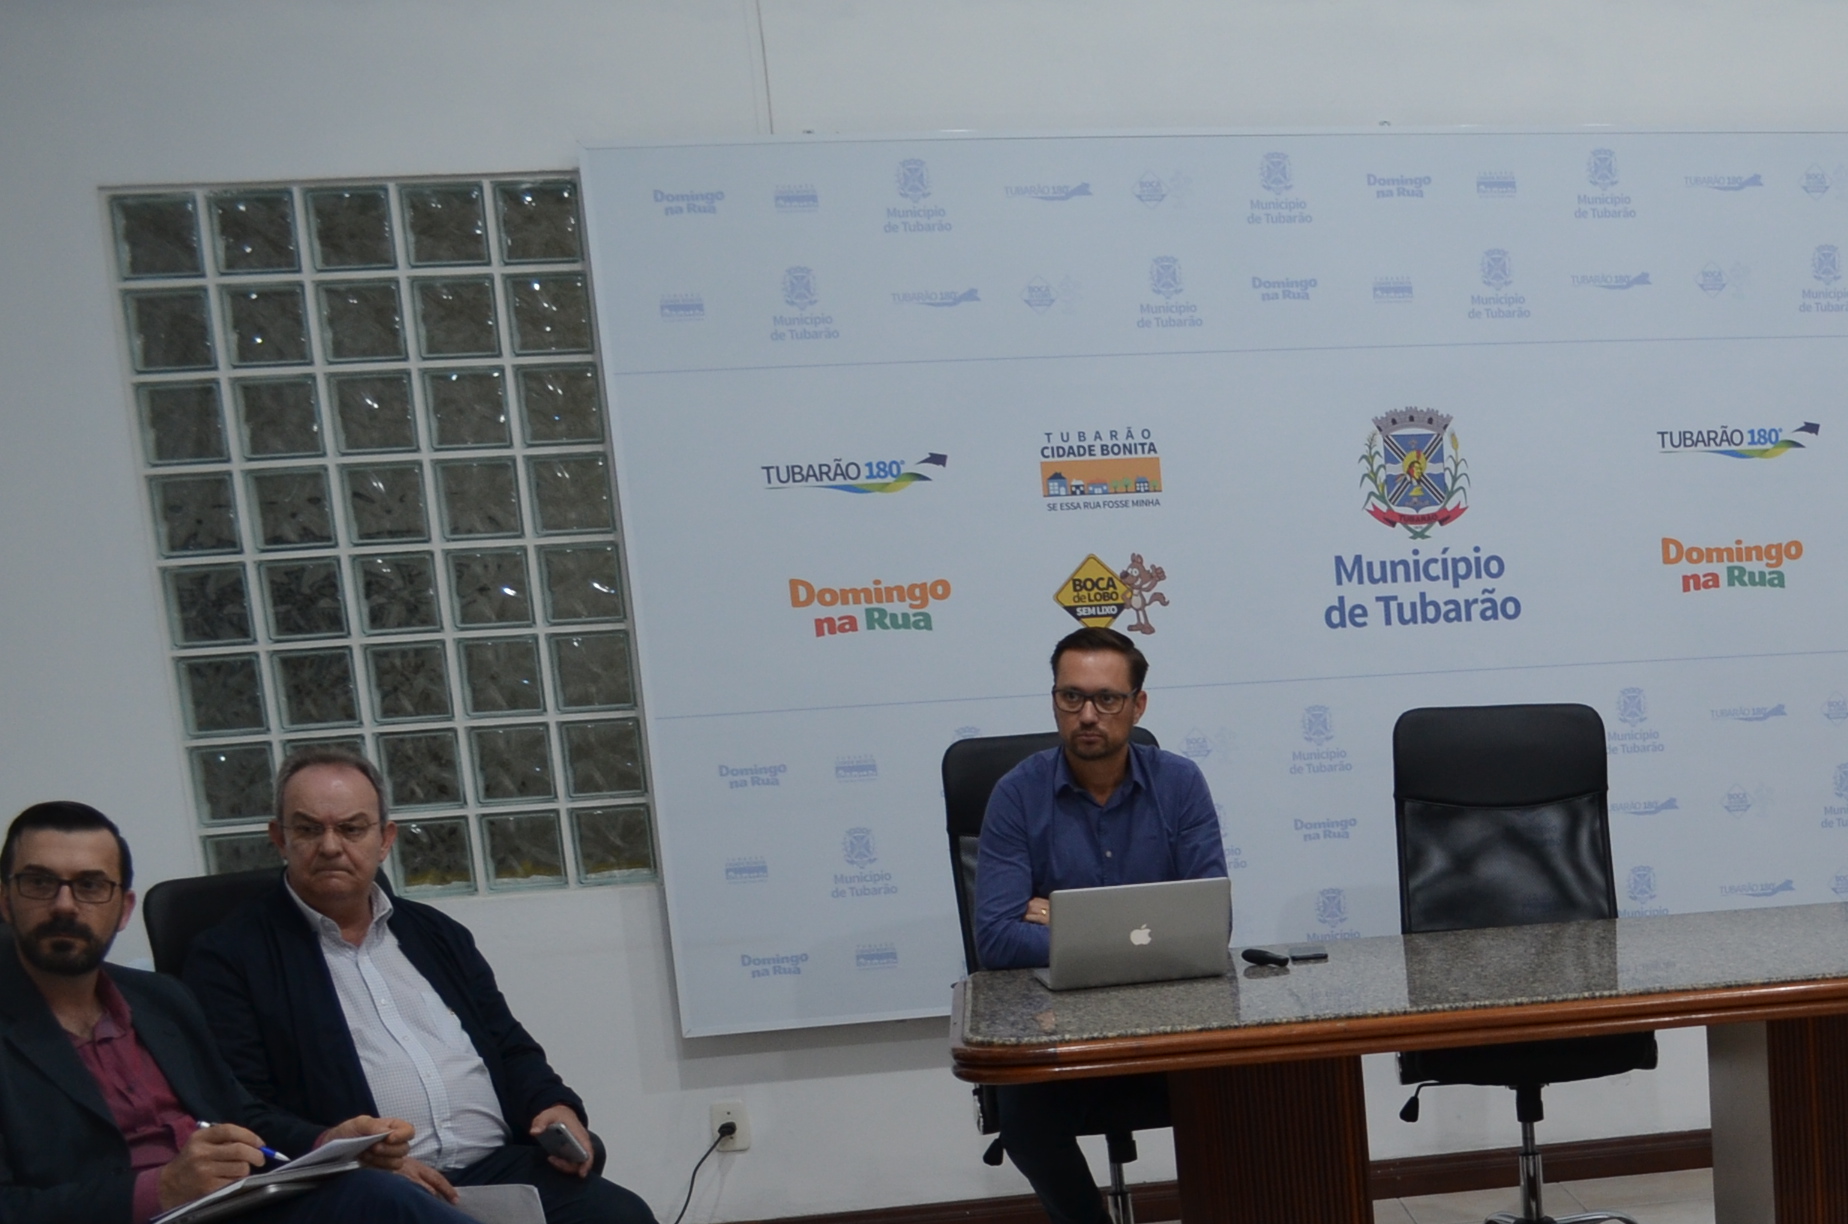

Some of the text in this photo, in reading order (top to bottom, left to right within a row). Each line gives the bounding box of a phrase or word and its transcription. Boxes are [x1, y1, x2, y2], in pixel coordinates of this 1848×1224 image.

[1367, 173, 1431, 188] Domingo
[653, 189, 725, 205] Domingo
[1397, 186, 1424, 198] Rua
[687, 202, 716, 214] Rua
[1252, 276, 1317, 291] Domingo
[1282, 288, 1310, 300] Rua
[1044, 427, 1152, 443] TUBARÃO
[1657, 425, 1744, 448] TUBARÃO
[1040, 442, 1158, 459] CIDADE BONITA
[761, 458, 861, 485] TUBARÃO
[1047, 498, 1160, 512] SE ESSA RUA FOSSE MINHA
[1661, 537, 1802, 567] Domingo
[1334, 546, 1505, 588] Município
[1072, 577, 1117, 592] BOCA
[1682, 565, 1785, 592] na Rua
[788, 578, 951, 609] Domingo
[1073, 591, 1119, 603] de LOBO
[1076, 604, 1117, 616] SEM LIXO
[1324, 588, 1521, 629] de Tubarão
[815, 607, 933, 637] na Rua
[718, 762, 787, 778] Domingo
[750, 775, 780, 787] Rua
[1294, 817, 1357, 831] Domingo
[1324, 827, 1350, 839] Rua
[741, 952, 809, 968] Domingo
[772, 964, 801, 976] Rua
